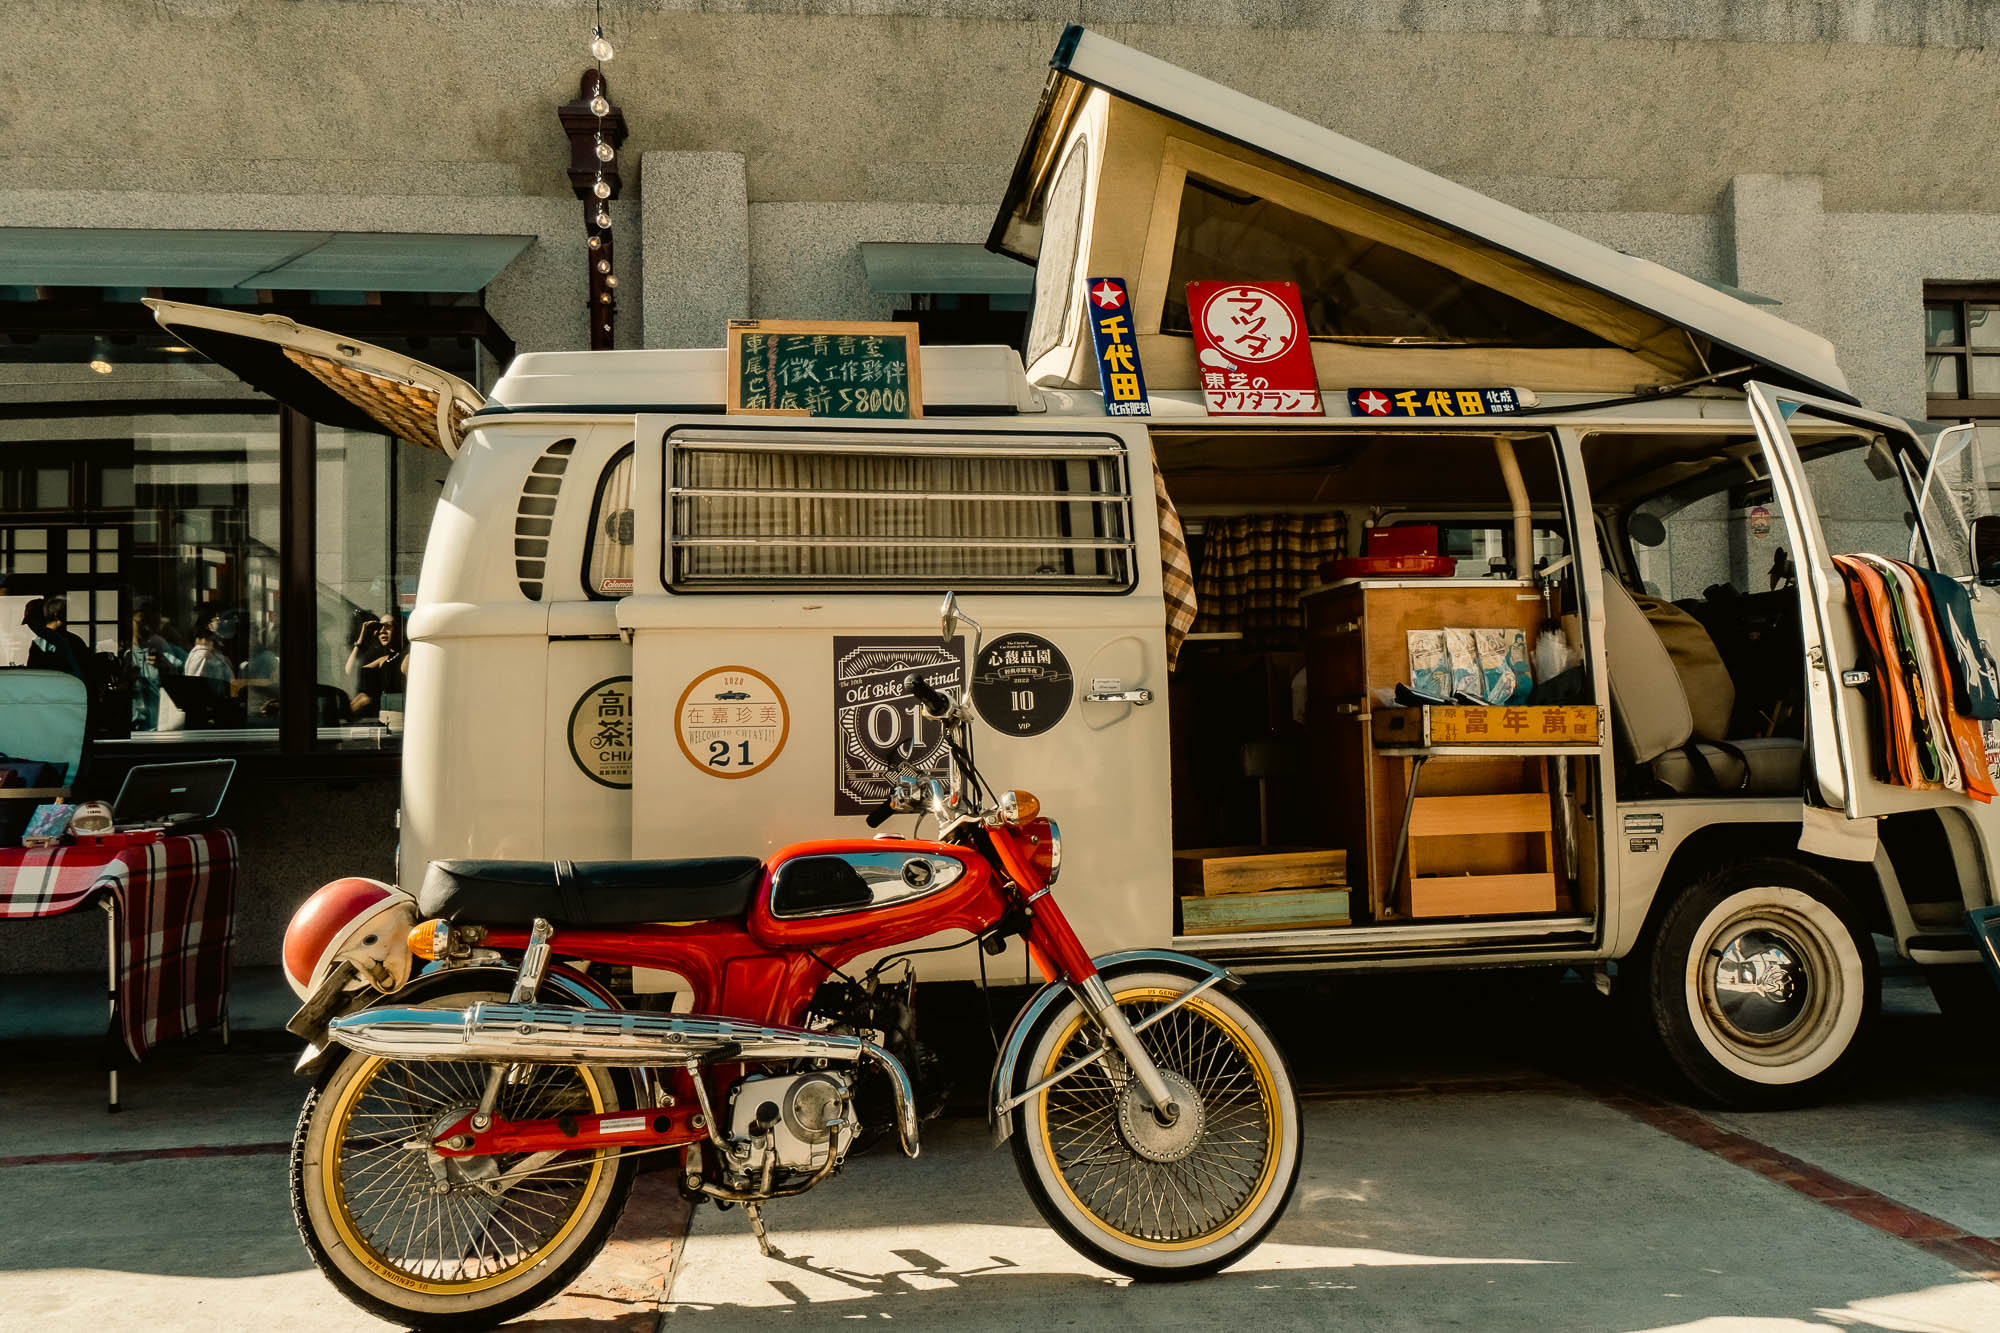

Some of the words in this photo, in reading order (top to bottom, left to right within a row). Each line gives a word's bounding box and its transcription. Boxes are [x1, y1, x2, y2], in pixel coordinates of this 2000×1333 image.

[1227, 298, 1271, 356] マツダ
[1099, 315, 1141, 400] 千代田
[1205, 373, 1269, 390] 東芝の
[1394, 390, 1486, 416] 千代田
[1486, 390, 1513, 403] 化成
[598, 689, 632, 717] 高
[846, 684, 871, 703] Old
[872, 679, 903, 698] Bike
[1011, 691, 1034, 711] 10
[590, 720, 632, 749] 茶
[689, 730, 721, 745] WELCOME
[868, 703, 927, 749] 01
[708, 740, 754, 767] 21
[367, 1258, 381, 1271] RIM
[382, 1269, 416, 1287] GENUINE
